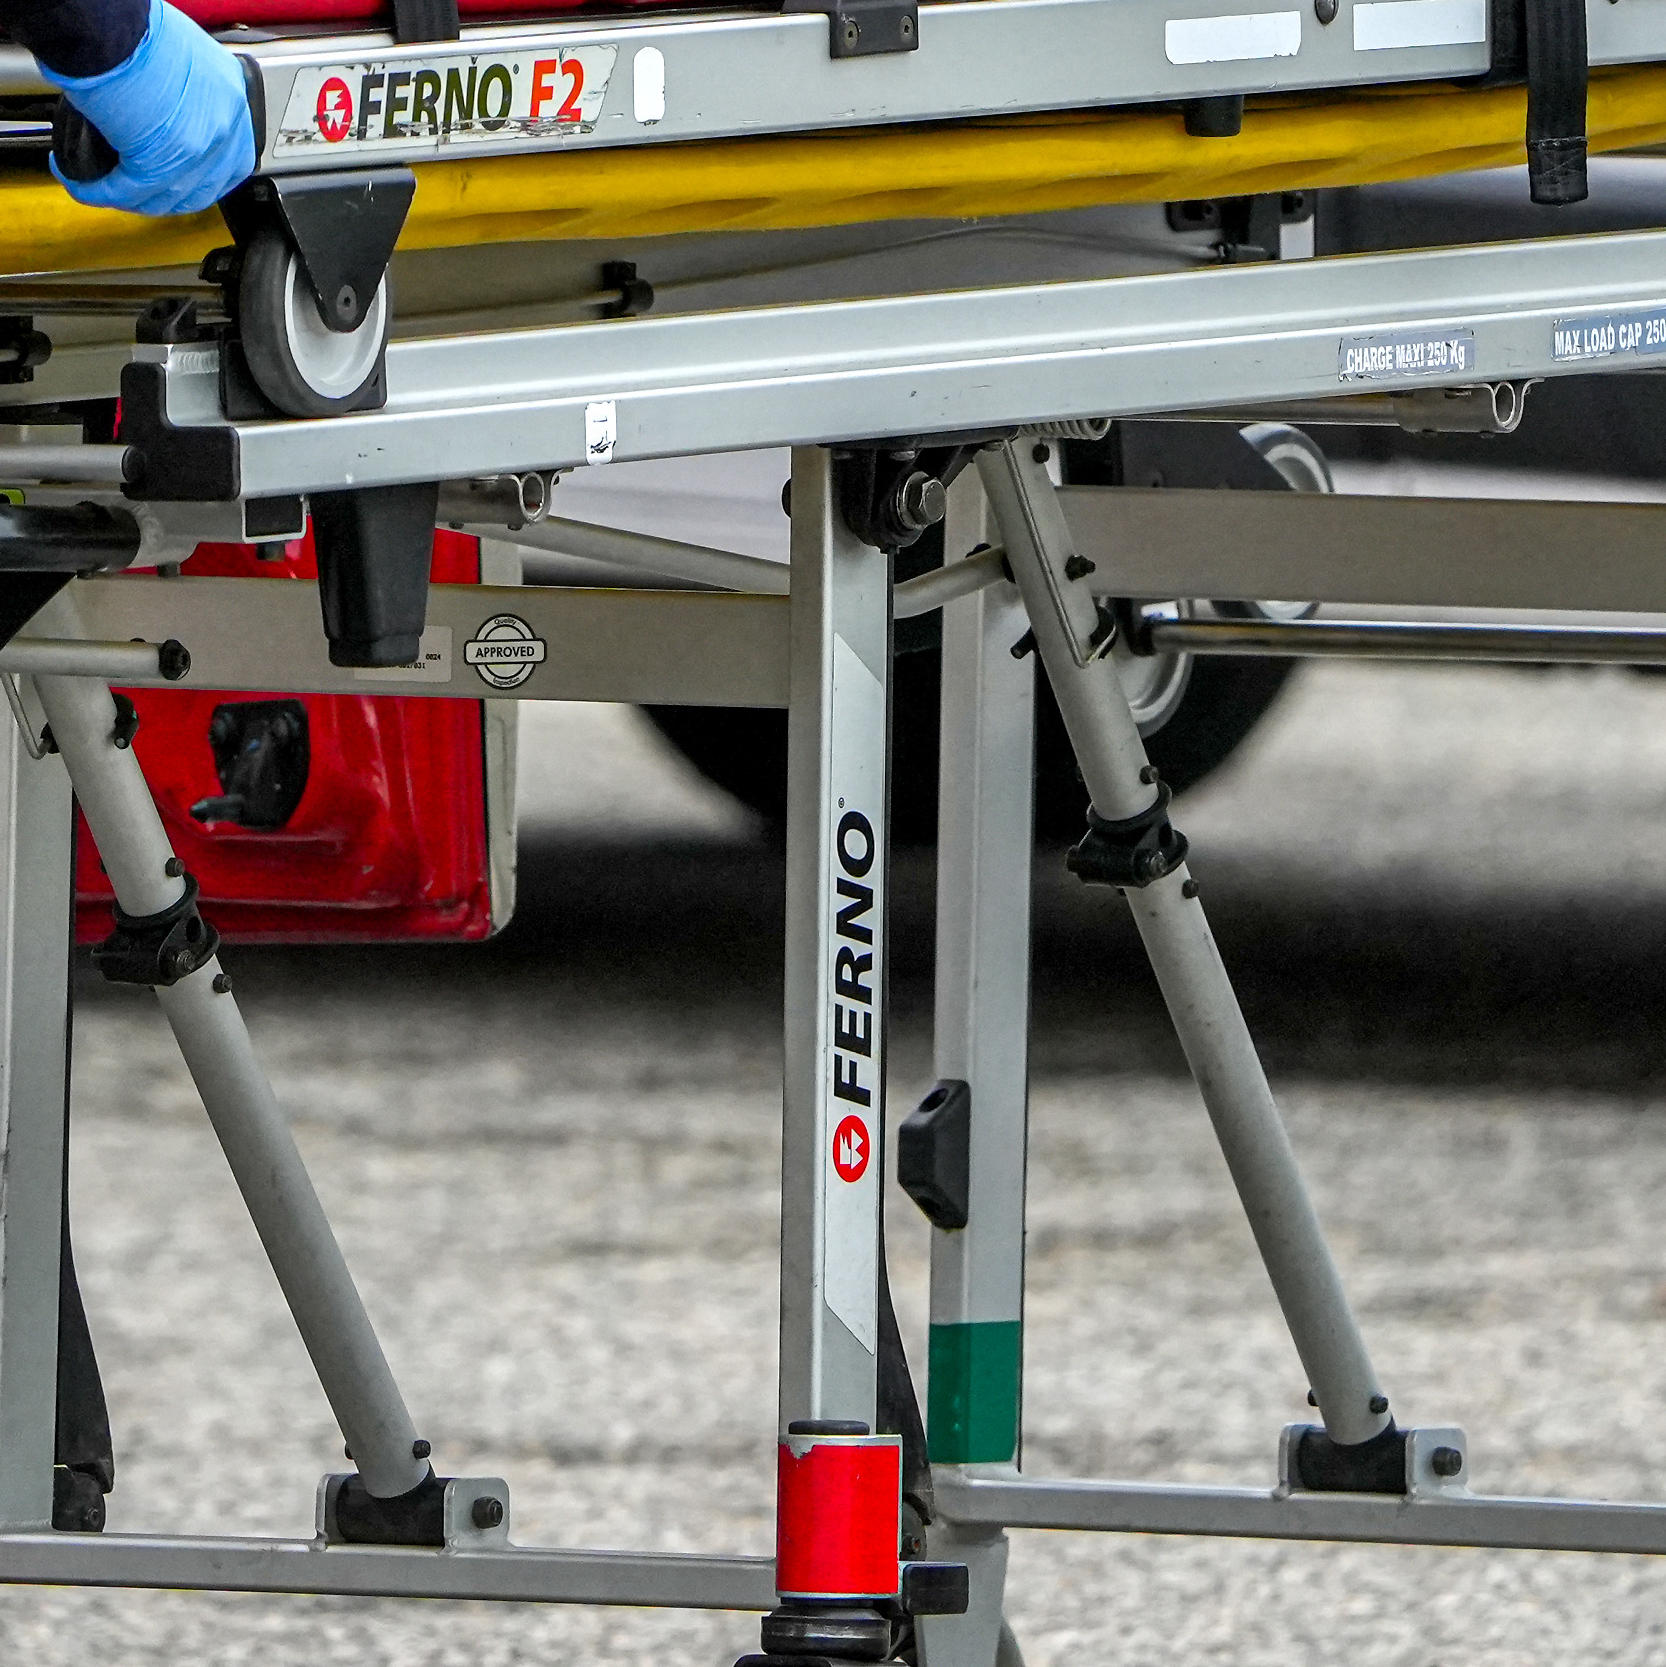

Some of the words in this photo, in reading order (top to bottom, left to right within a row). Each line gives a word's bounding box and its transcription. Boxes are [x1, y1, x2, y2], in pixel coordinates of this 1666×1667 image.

[357, 63, 513, 140] FERNO
[529, 58, 585, 125] F2
[1554, 329, 1581, 355] MAX
[1584, 324, 1616, 353] LOAD
[1619, 322, 1643, 351] CAP
[1346, 345, 1394, 373] CHARGE
[1395, 342, 1425, 369] MAXI
[1427, 340, 1448, 367] 250
[1449, 339, 1466, 370] Kg
[475, 646, 535, 658] APPROVED
[833, 810, 876, 1108] FERNO
